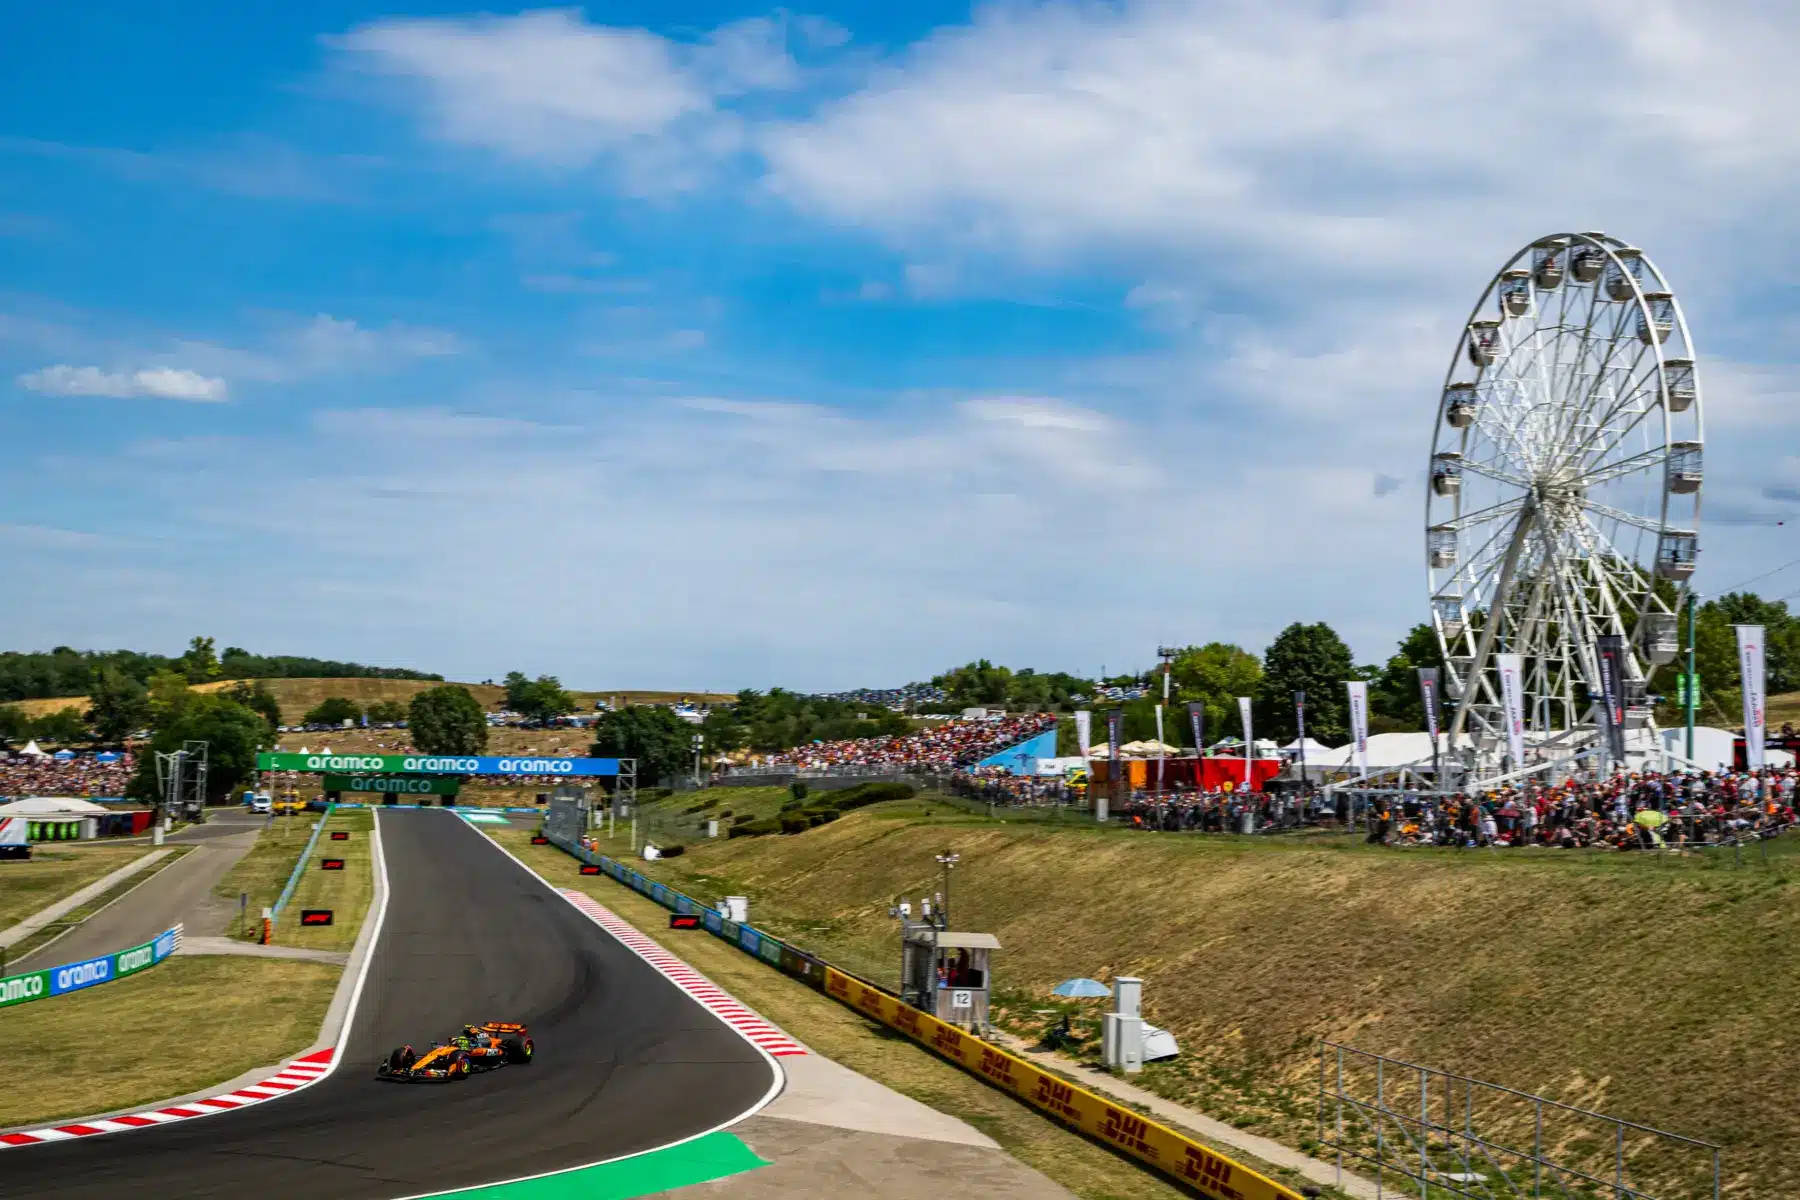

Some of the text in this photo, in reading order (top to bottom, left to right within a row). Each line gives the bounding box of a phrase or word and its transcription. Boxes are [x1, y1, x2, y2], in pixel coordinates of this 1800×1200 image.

[307, 756, 384, 770] aramco
[403, 757, 479, 771] aramco
[498, 758, 573, 773] aramco
[351, 777, 432, 793] aramco
[58, 960, 109, 989] aramco
[956, 993, 969, 1004] 12
[1101, 1107, 1154, 1156] DHL
